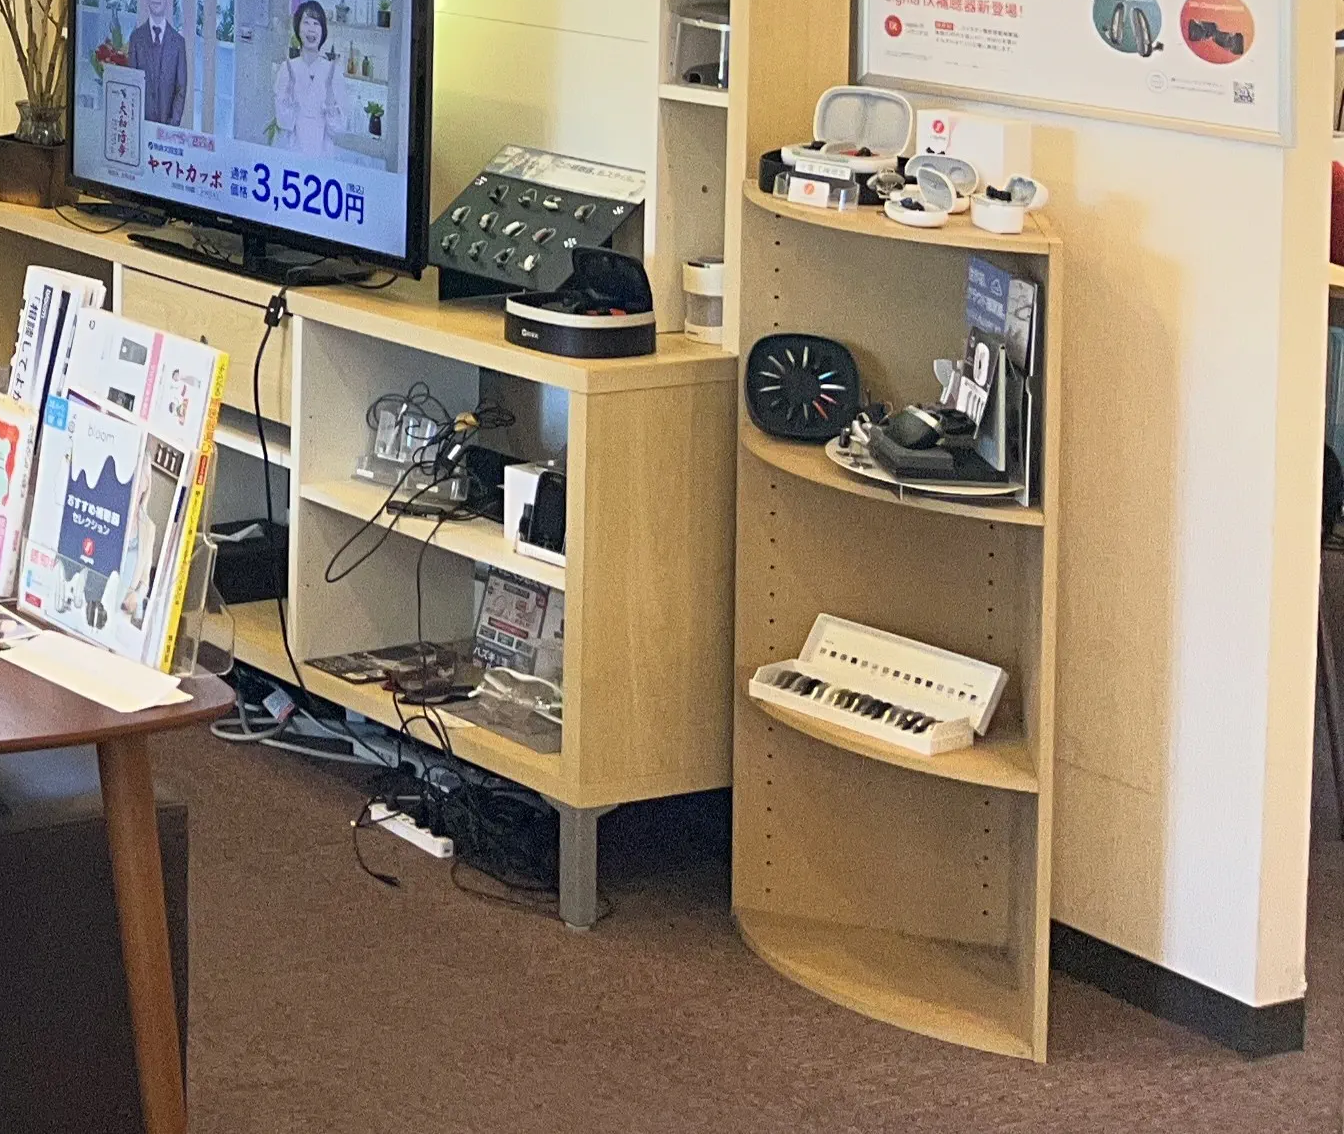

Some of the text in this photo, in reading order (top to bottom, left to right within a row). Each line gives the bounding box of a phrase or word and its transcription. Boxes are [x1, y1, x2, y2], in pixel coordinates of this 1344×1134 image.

[147, 153, 223, 189] ヤマトカッポ
[251, 162, 365, 226] 3,520円
[71, 513, 111, 536] セレクション
